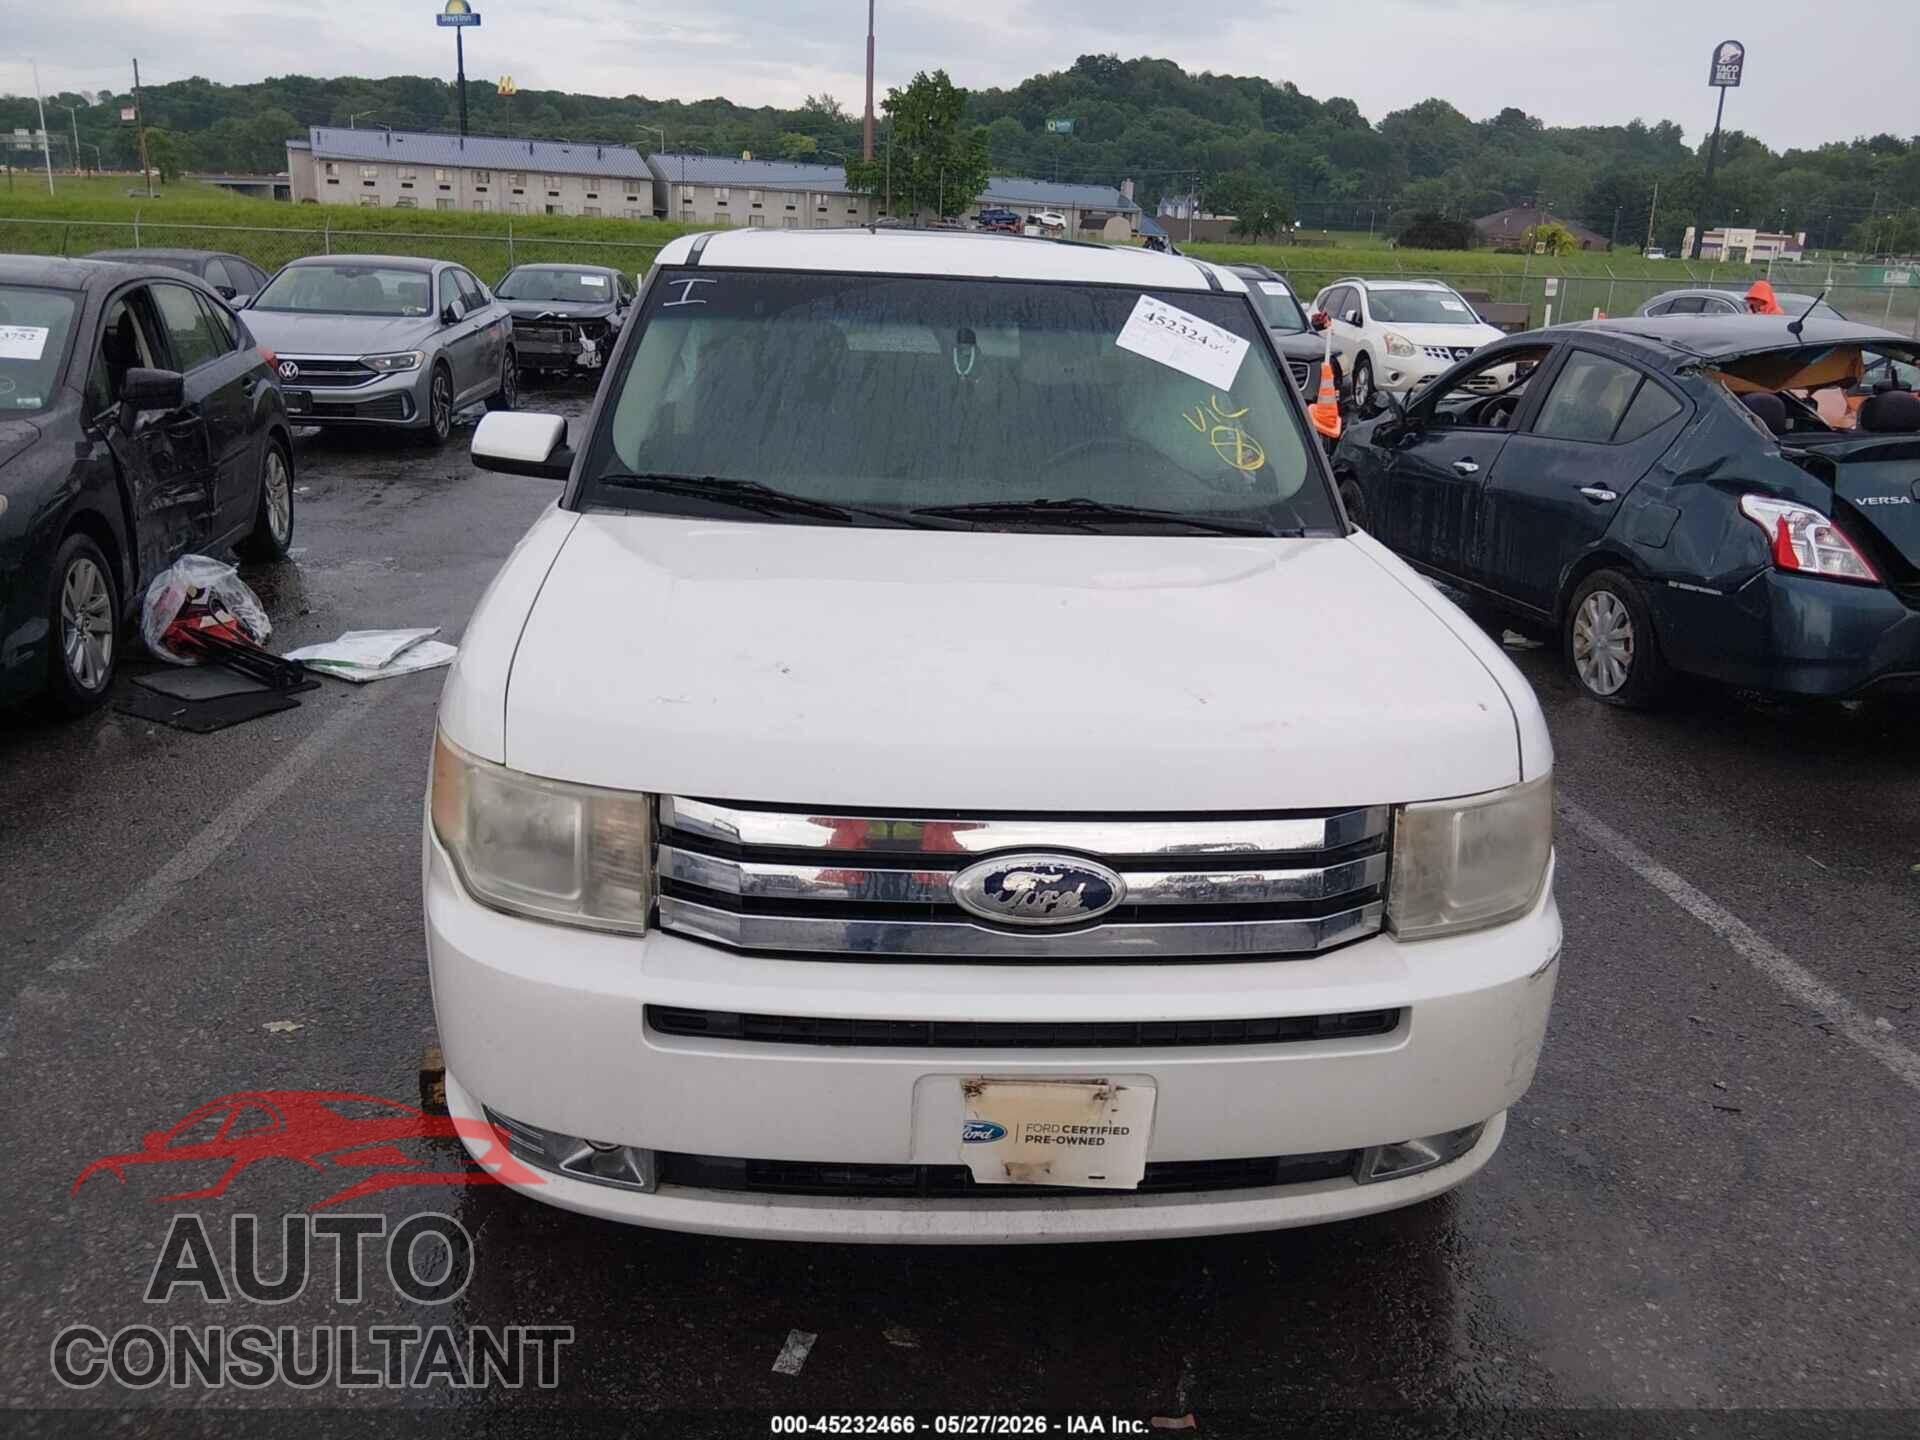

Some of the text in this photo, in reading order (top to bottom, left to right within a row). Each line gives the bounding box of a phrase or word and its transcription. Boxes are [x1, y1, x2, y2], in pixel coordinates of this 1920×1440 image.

[1717, 64, 1740, 72] TACO
[1715, 72, 1738, 80] BELL
[1855, 496, 1911, 505] VERSA
[992, 870, 1087, 914] Ford
[1026, 1123, 1130, 1136] FORD CERTIFIED
[1025, 1135, 1105, 1146] PRE-OWNED
